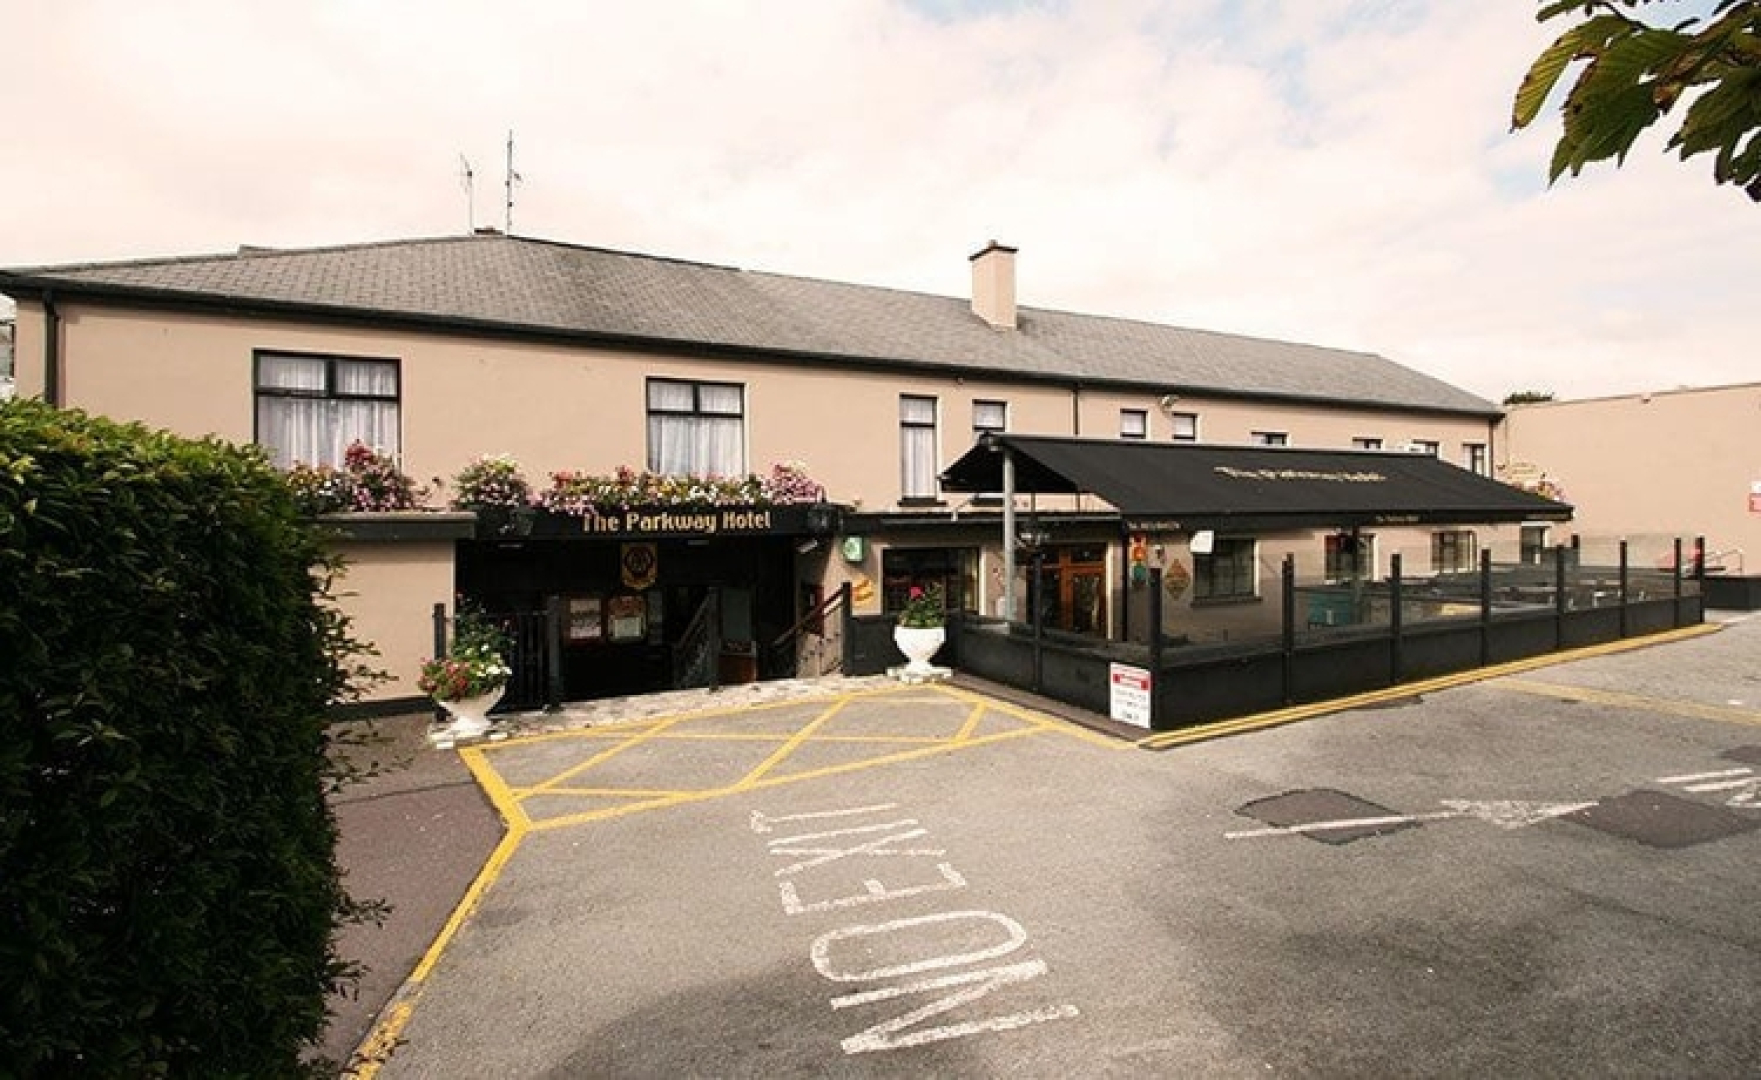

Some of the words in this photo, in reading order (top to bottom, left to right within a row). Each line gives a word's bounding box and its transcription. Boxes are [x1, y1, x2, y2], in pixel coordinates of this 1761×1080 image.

[582, 512, 620, 532] The
[626, 511, 717, 534] Parkway
[722, 510, 771, 530] Hotel
[750, 802, 967, 915] EXIT
[810, 910, 1080, 1054] NO
